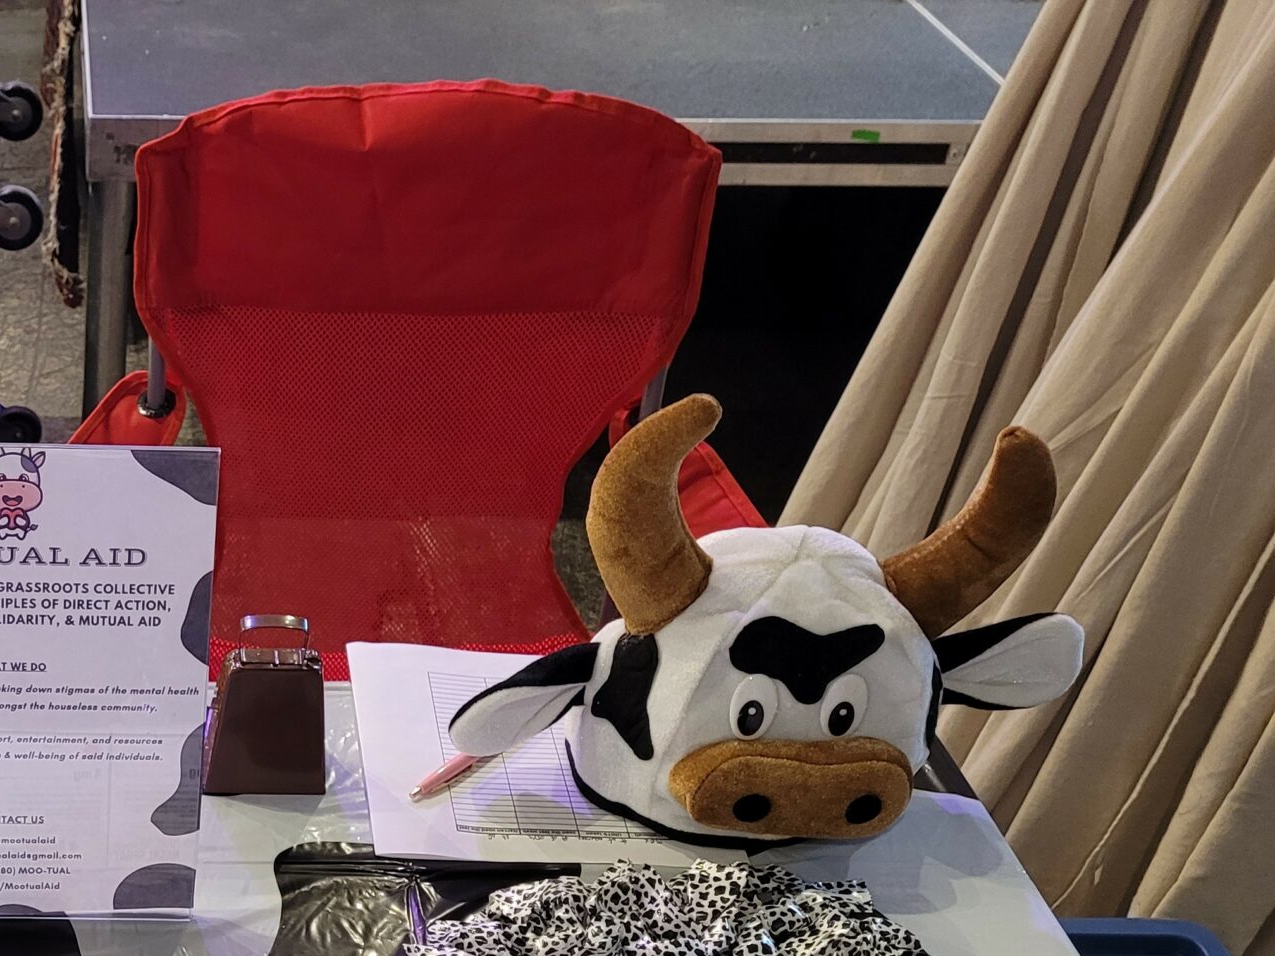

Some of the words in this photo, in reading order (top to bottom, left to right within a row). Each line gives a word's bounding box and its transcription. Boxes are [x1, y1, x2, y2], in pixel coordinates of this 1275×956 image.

[78, 547, 146, 566] AID
[93, 582, 175, 595] COLLECTIVE
[40, 597, 59, 609] OF
[62, 598, 110, 610] DIRECT
[113, 599, 171, 612] ACTION,
[64, 614, 75, 625] &
[78, 614, 133, 626] MUTUAL
[137, 615, 161, 627] AID
[9, 661, 27, 672] WE
[27, 661, 46, 672] DO
[25, 683, 52, 693] down
[54, 685, 95, 696] stigmas
[110, 684, 127, 694] the
[129, 685, 166, 695] mental
[166, 685, 199, 695] health
[29, 700, 45, 710] the
[47, 701, 98, 711] houseless
[91, 734, 112, 744] and
[13, 750, 66, 762] well-being
[80, 751, 104, 760] said
[17, 866, 71, 874] MOO-TUAL
